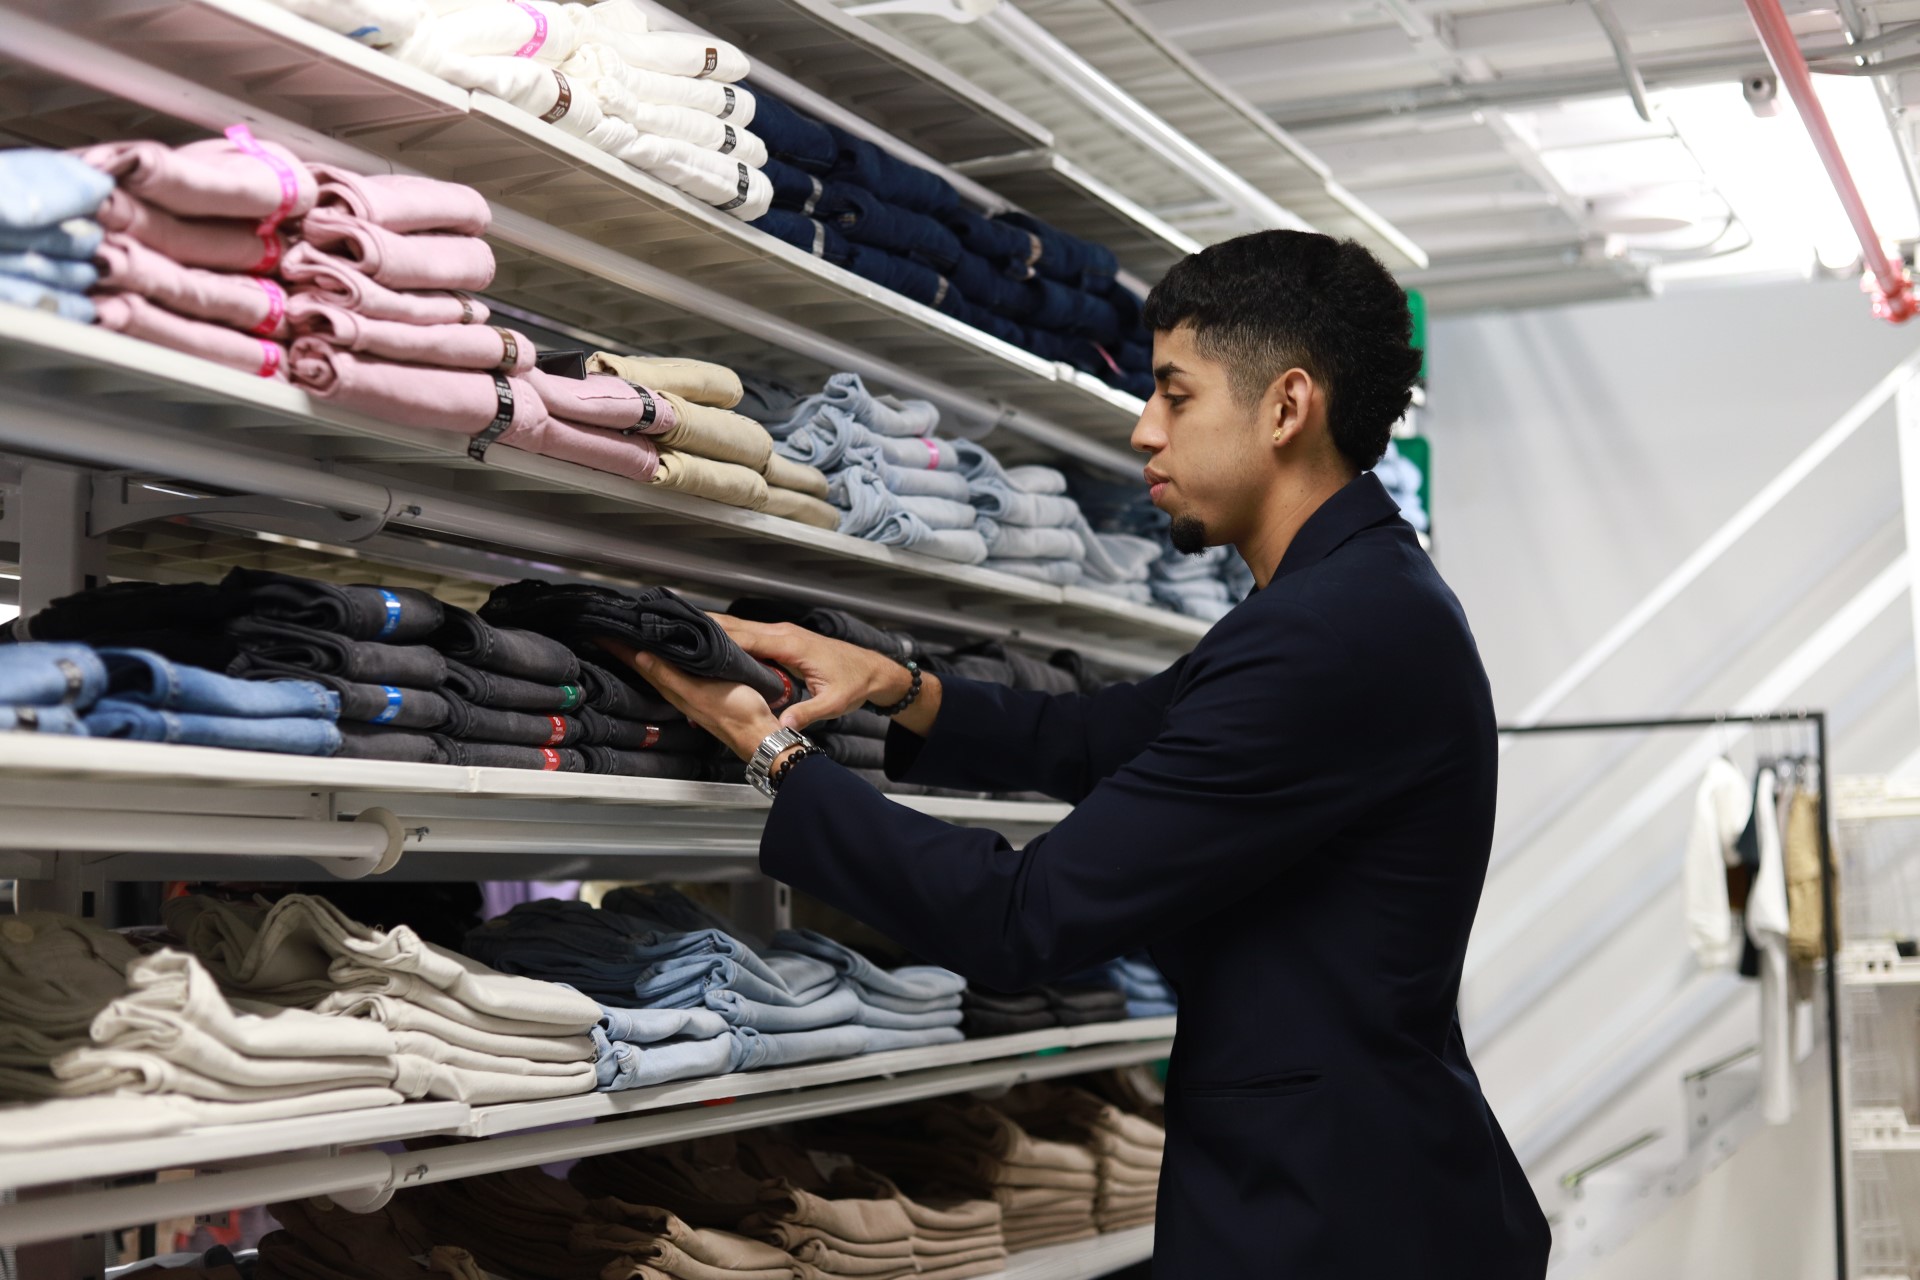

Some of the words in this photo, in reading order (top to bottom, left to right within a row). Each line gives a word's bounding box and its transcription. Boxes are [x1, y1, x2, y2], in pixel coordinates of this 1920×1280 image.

[706, 59, 716, 70] 10
[552, 105, 565, 117] 10
[505, 343, 517, 358] 10
